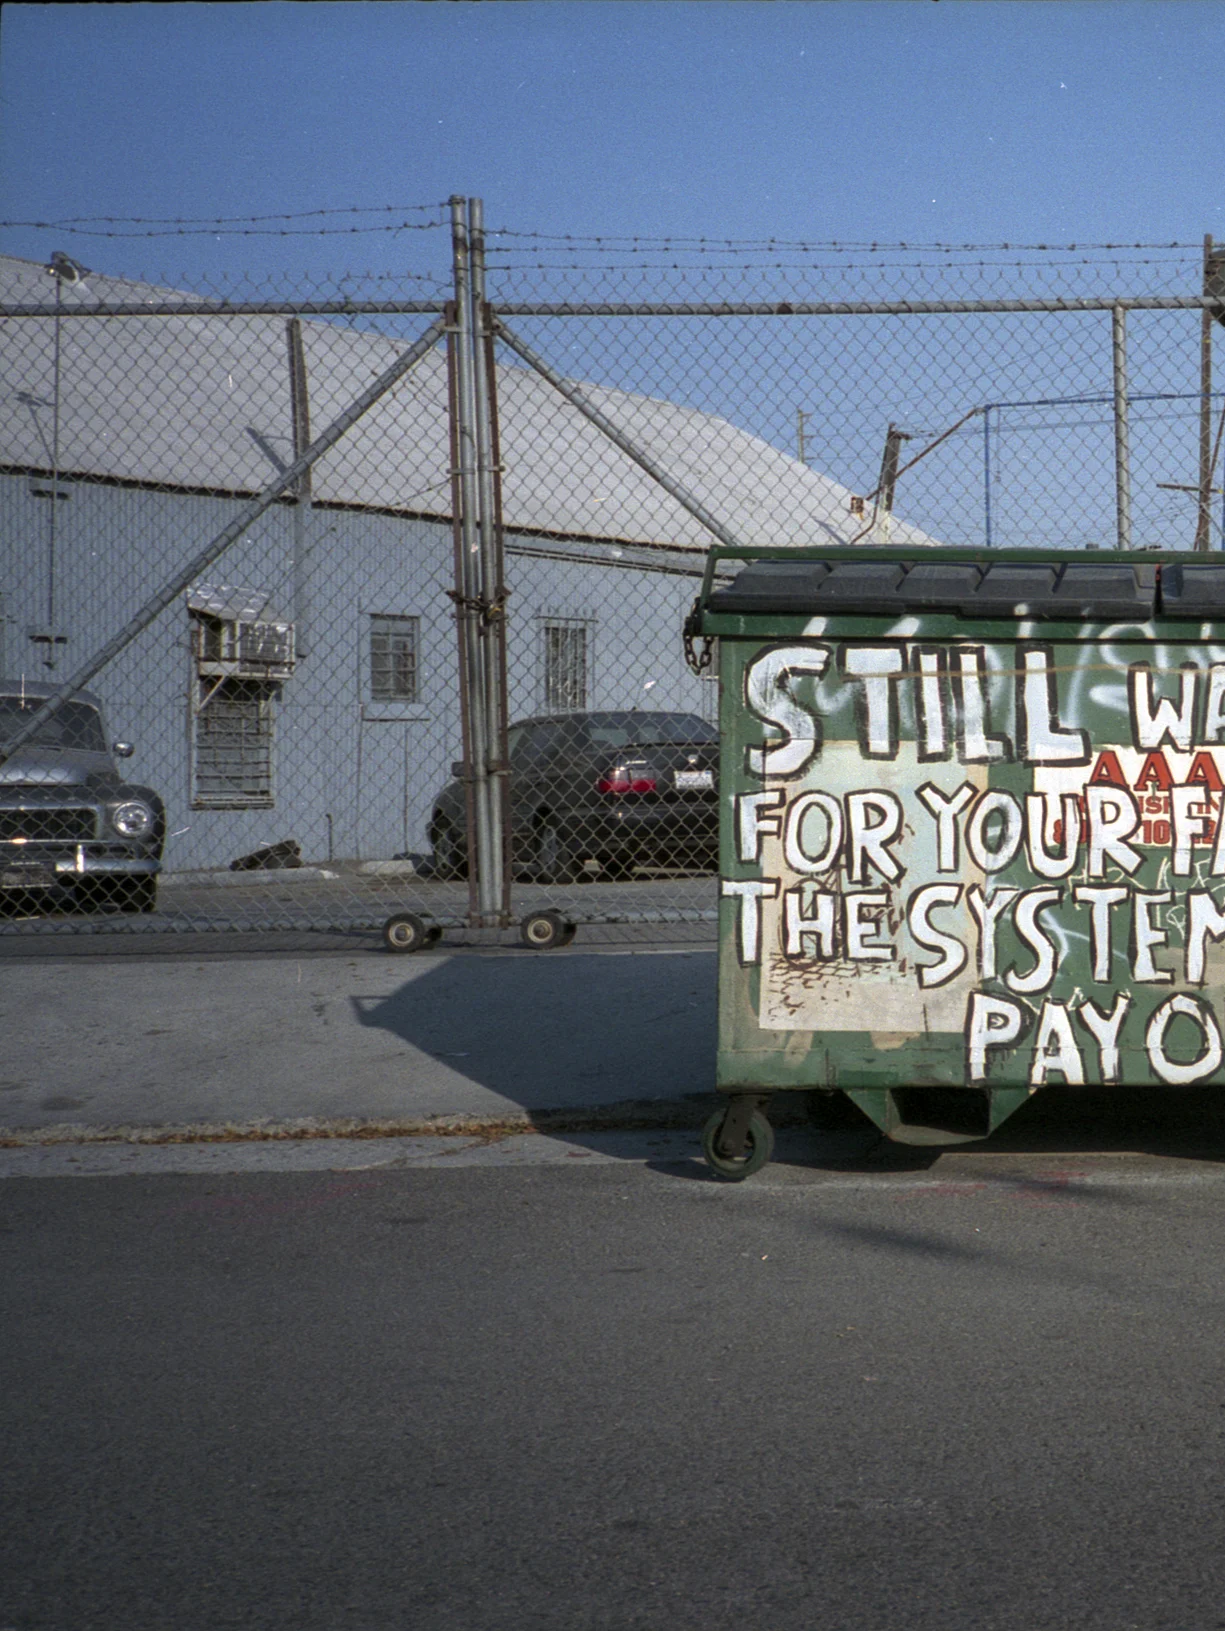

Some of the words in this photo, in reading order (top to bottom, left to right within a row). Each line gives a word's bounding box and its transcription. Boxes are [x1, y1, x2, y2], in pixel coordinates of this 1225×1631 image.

[743, 642, 1092, 778] STILL
[1089, 751, 1225, 792] AAA
[735, 788, 904, 885] FOR
[917, 782, 1147, 880] YOUR
[722, 878, 896, 966] THE
[966, 990, 1132, 1086] PAY
